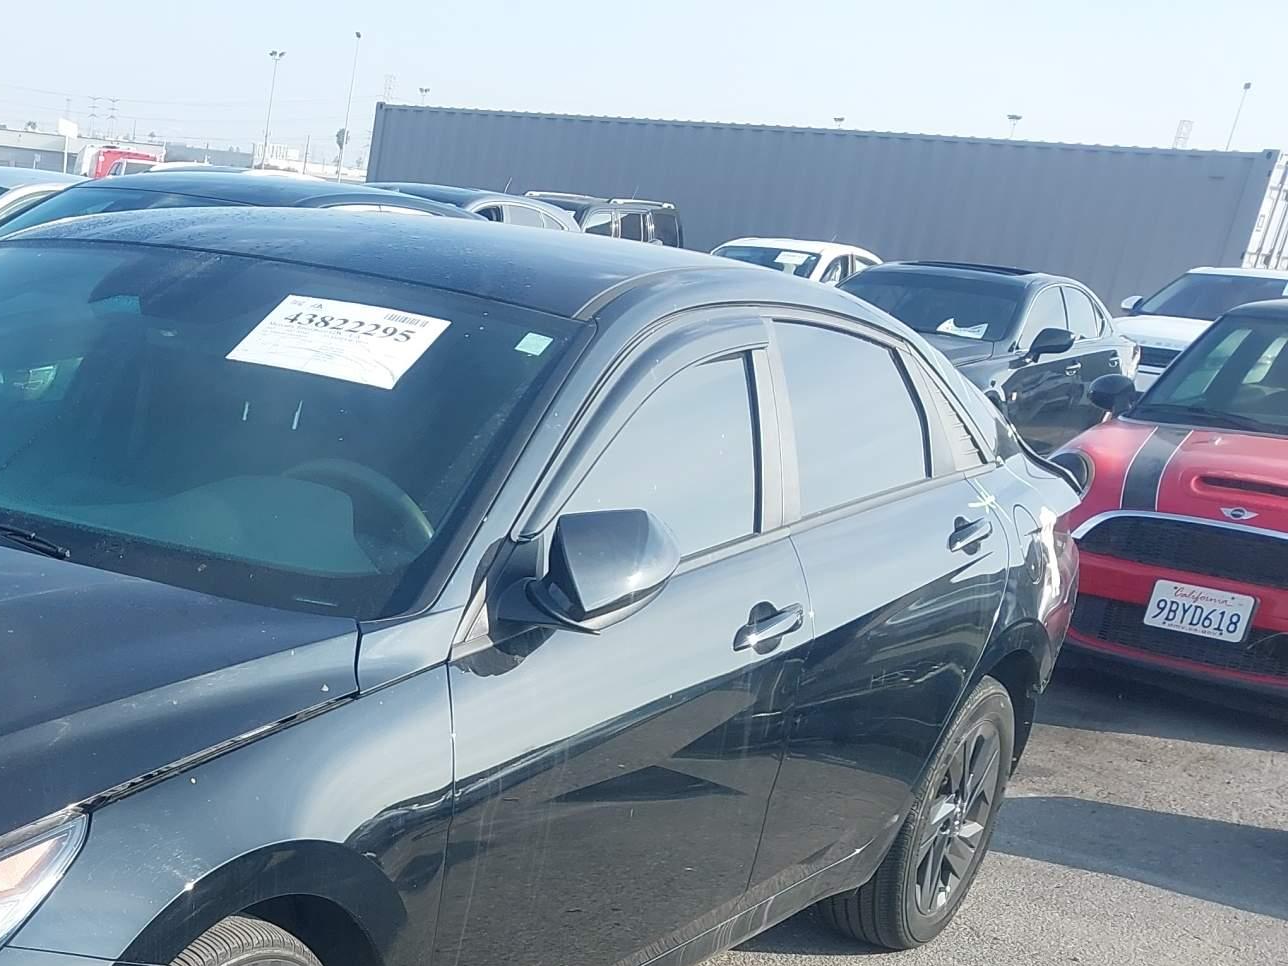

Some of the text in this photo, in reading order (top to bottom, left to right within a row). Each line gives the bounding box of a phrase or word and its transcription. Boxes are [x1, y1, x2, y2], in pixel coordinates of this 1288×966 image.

[284, 311, 416, 343] 43822295
[1173, 587, 1234, 607] California
[1152, 598, 1242, 634] 9BYD618
